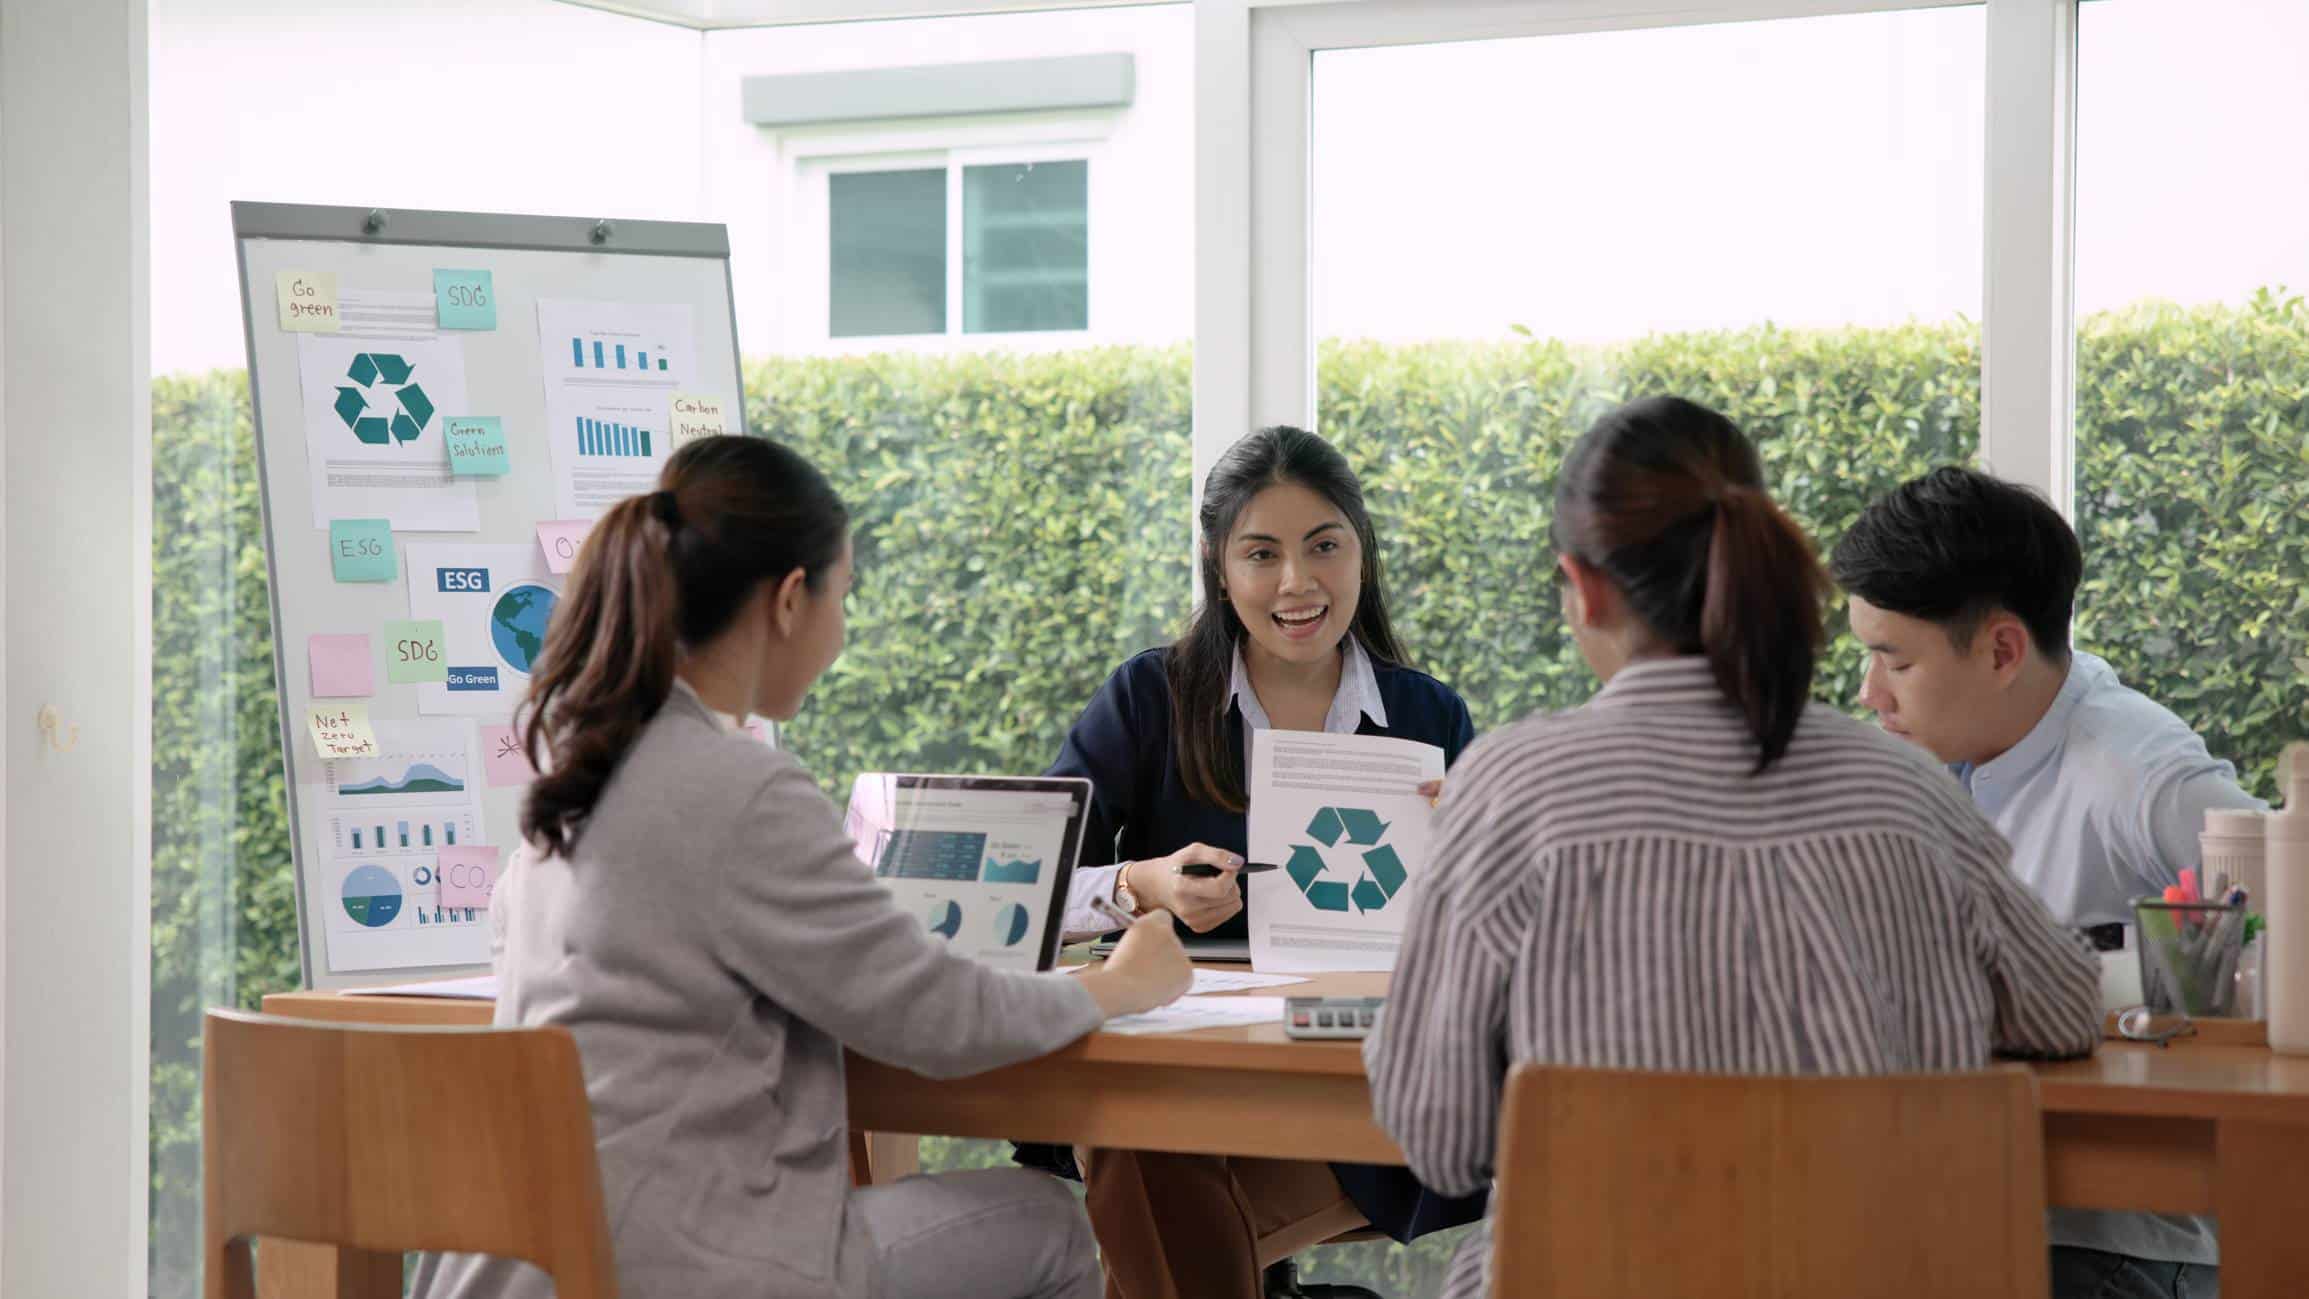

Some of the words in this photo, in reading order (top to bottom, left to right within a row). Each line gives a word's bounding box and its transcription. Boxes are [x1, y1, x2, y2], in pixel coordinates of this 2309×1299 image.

[292, 279, 315, 297] Go
[448, 284, 487, 307] SDG
[289, 302, 334, 318] green
[675, 399, 719, 415] Carbon
[450, 422, 486, 436] Green
[340, 538, 382, 557] ESG
[445, 571, 482, 590] ESG
[397, 639, 438, 662] SDG
[449, 674, 464, 685] Go
[465, 673, 496, 686] Green
[315, 711, 350, 729] Net
[327, 739, 373, 754] Target
